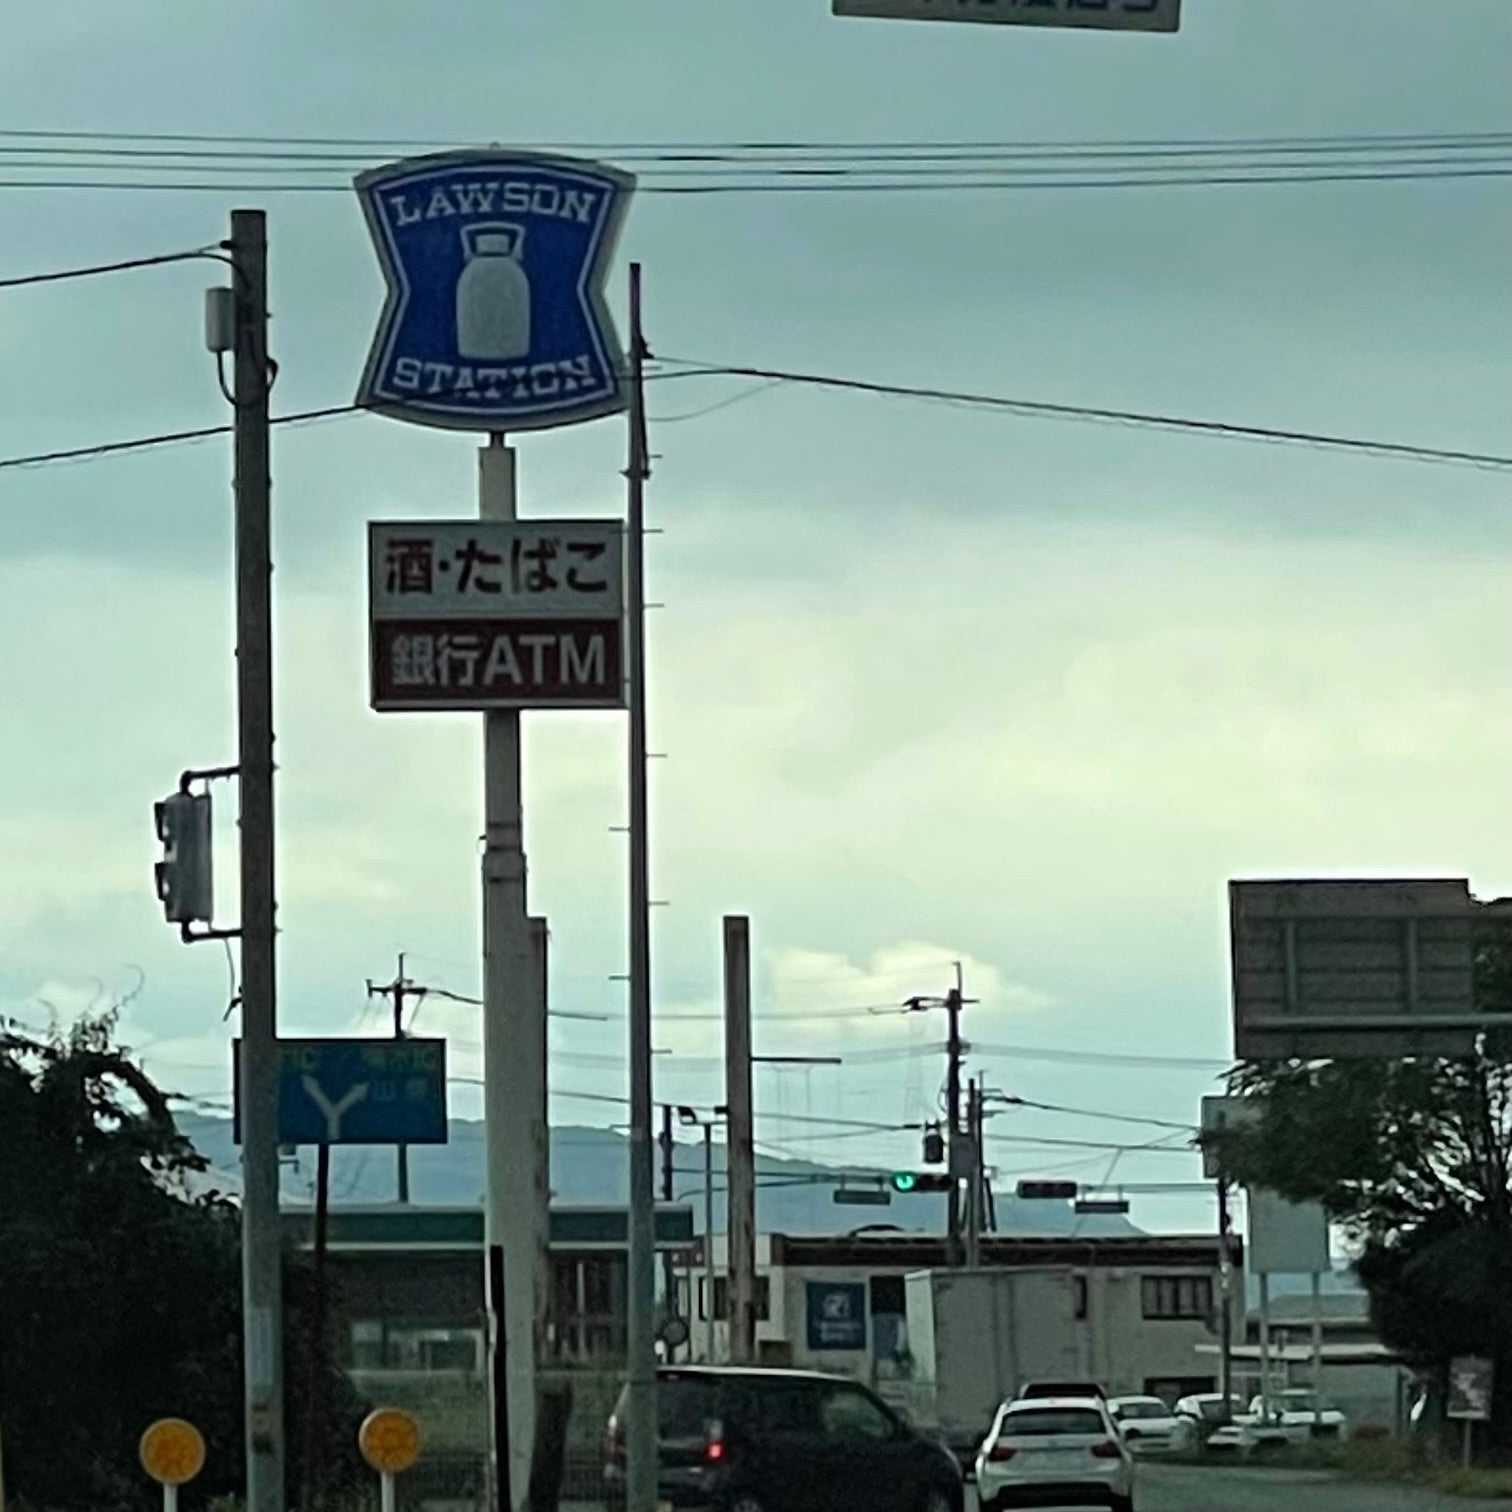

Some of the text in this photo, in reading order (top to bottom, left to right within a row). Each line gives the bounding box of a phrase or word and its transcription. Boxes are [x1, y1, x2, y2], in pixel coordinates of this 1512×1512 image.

[390, 181, 596, 227] LAWSON
[392, 354, 596, 400] STATION
[391, 633, 606, 687] 銀行ATM
